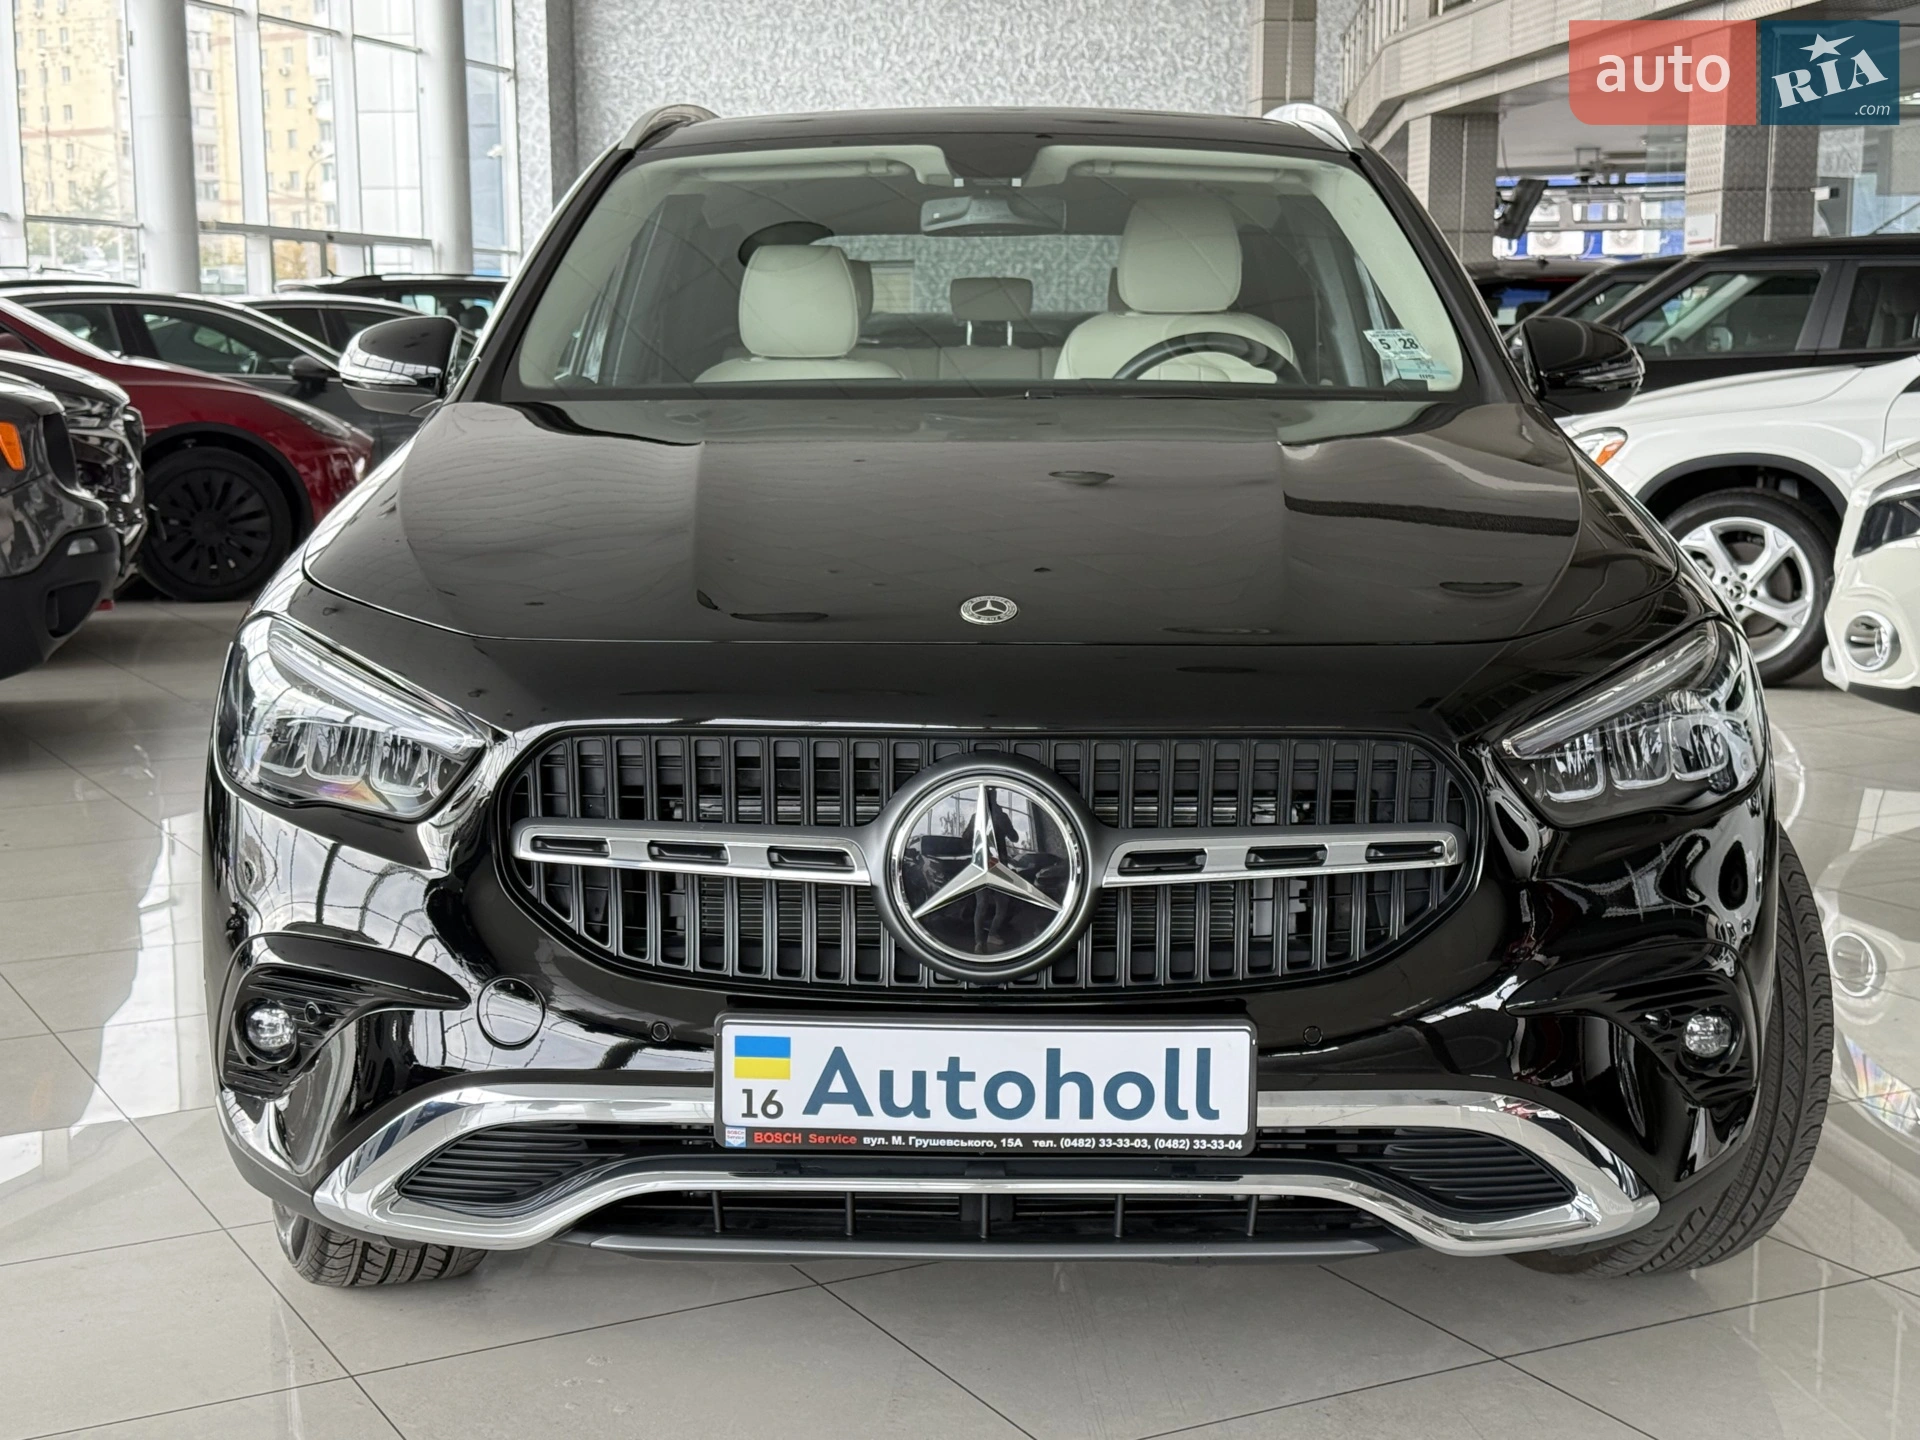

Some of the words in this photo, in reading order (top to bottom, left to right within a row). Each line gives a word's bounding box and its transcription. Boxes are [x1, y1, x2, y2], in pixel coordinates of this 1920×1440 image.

[1378, 338, 1391, 350] 5
[1398, 338, 1419, 350] 28
[802, 1045, 1220, 1121] Autoholl
[741, 1088, 785, 1119] 16
[753, 1132, 802, 1144] BOSCH
[808, 1133, 858, 1145] Service
[863, 1136, 889, 1147] вул.
[891, 1135, 906, 1146] М.
[908, 1136, 997, 1149] Грушевського,
[1001, 1138, 1024, 1148] 15А
[1032, 1139, 1057, 1148] тел.
[1060, 1137, 1096, 1149] (0482)
[1098, 1138, 1151, 1150] 33-33-03,
[1154, 1138, 1190, 1150] (0482)
[1193, 1139, 1243, 1150] 33-33-04
